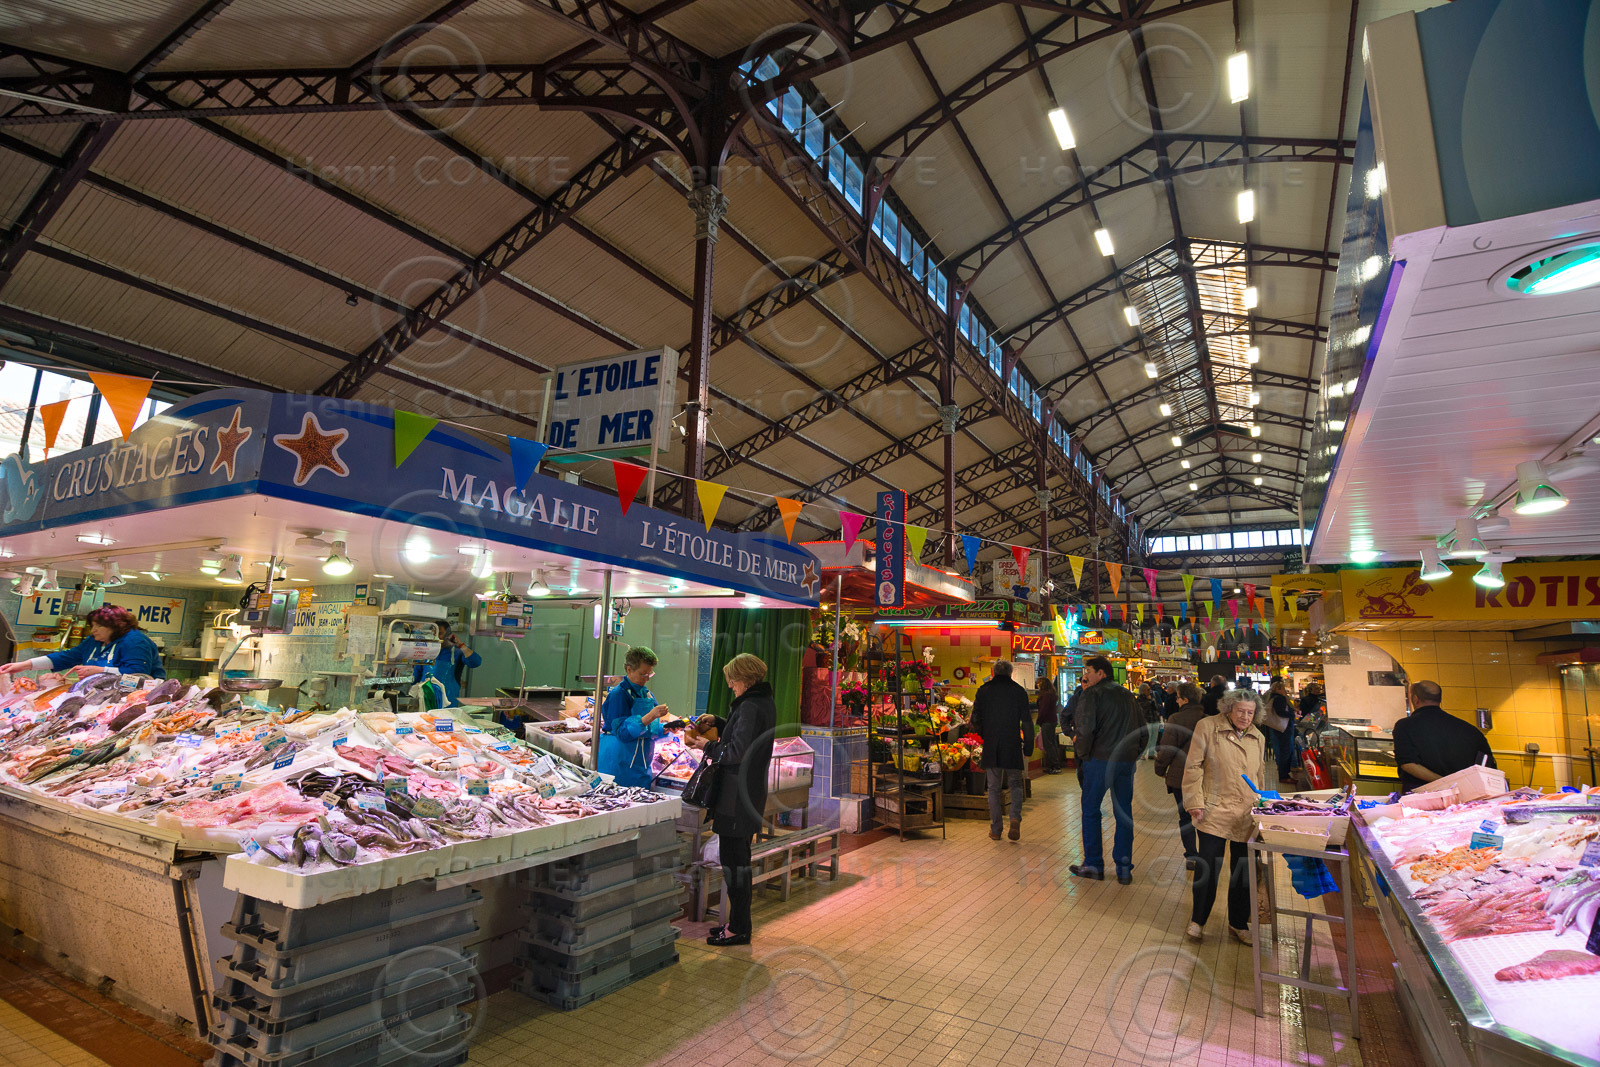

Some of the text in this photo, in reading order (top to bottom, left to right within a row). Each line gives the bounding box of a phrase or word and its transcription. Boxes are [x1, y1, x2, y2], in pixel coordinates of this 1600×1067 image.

[549, 408, 654, 449] DE MER
[53, 418, 210, 501] CRUSTACÉS
[440, 466, 600, 536] MAGALIE
[639, 520, 798, 586] L'ÉTOILE DE MER
[138, 604, 172, 625] MER
[966, 611, 998, 619] EMPORTER
[1012, 634, 1052, 652] PIZZA
